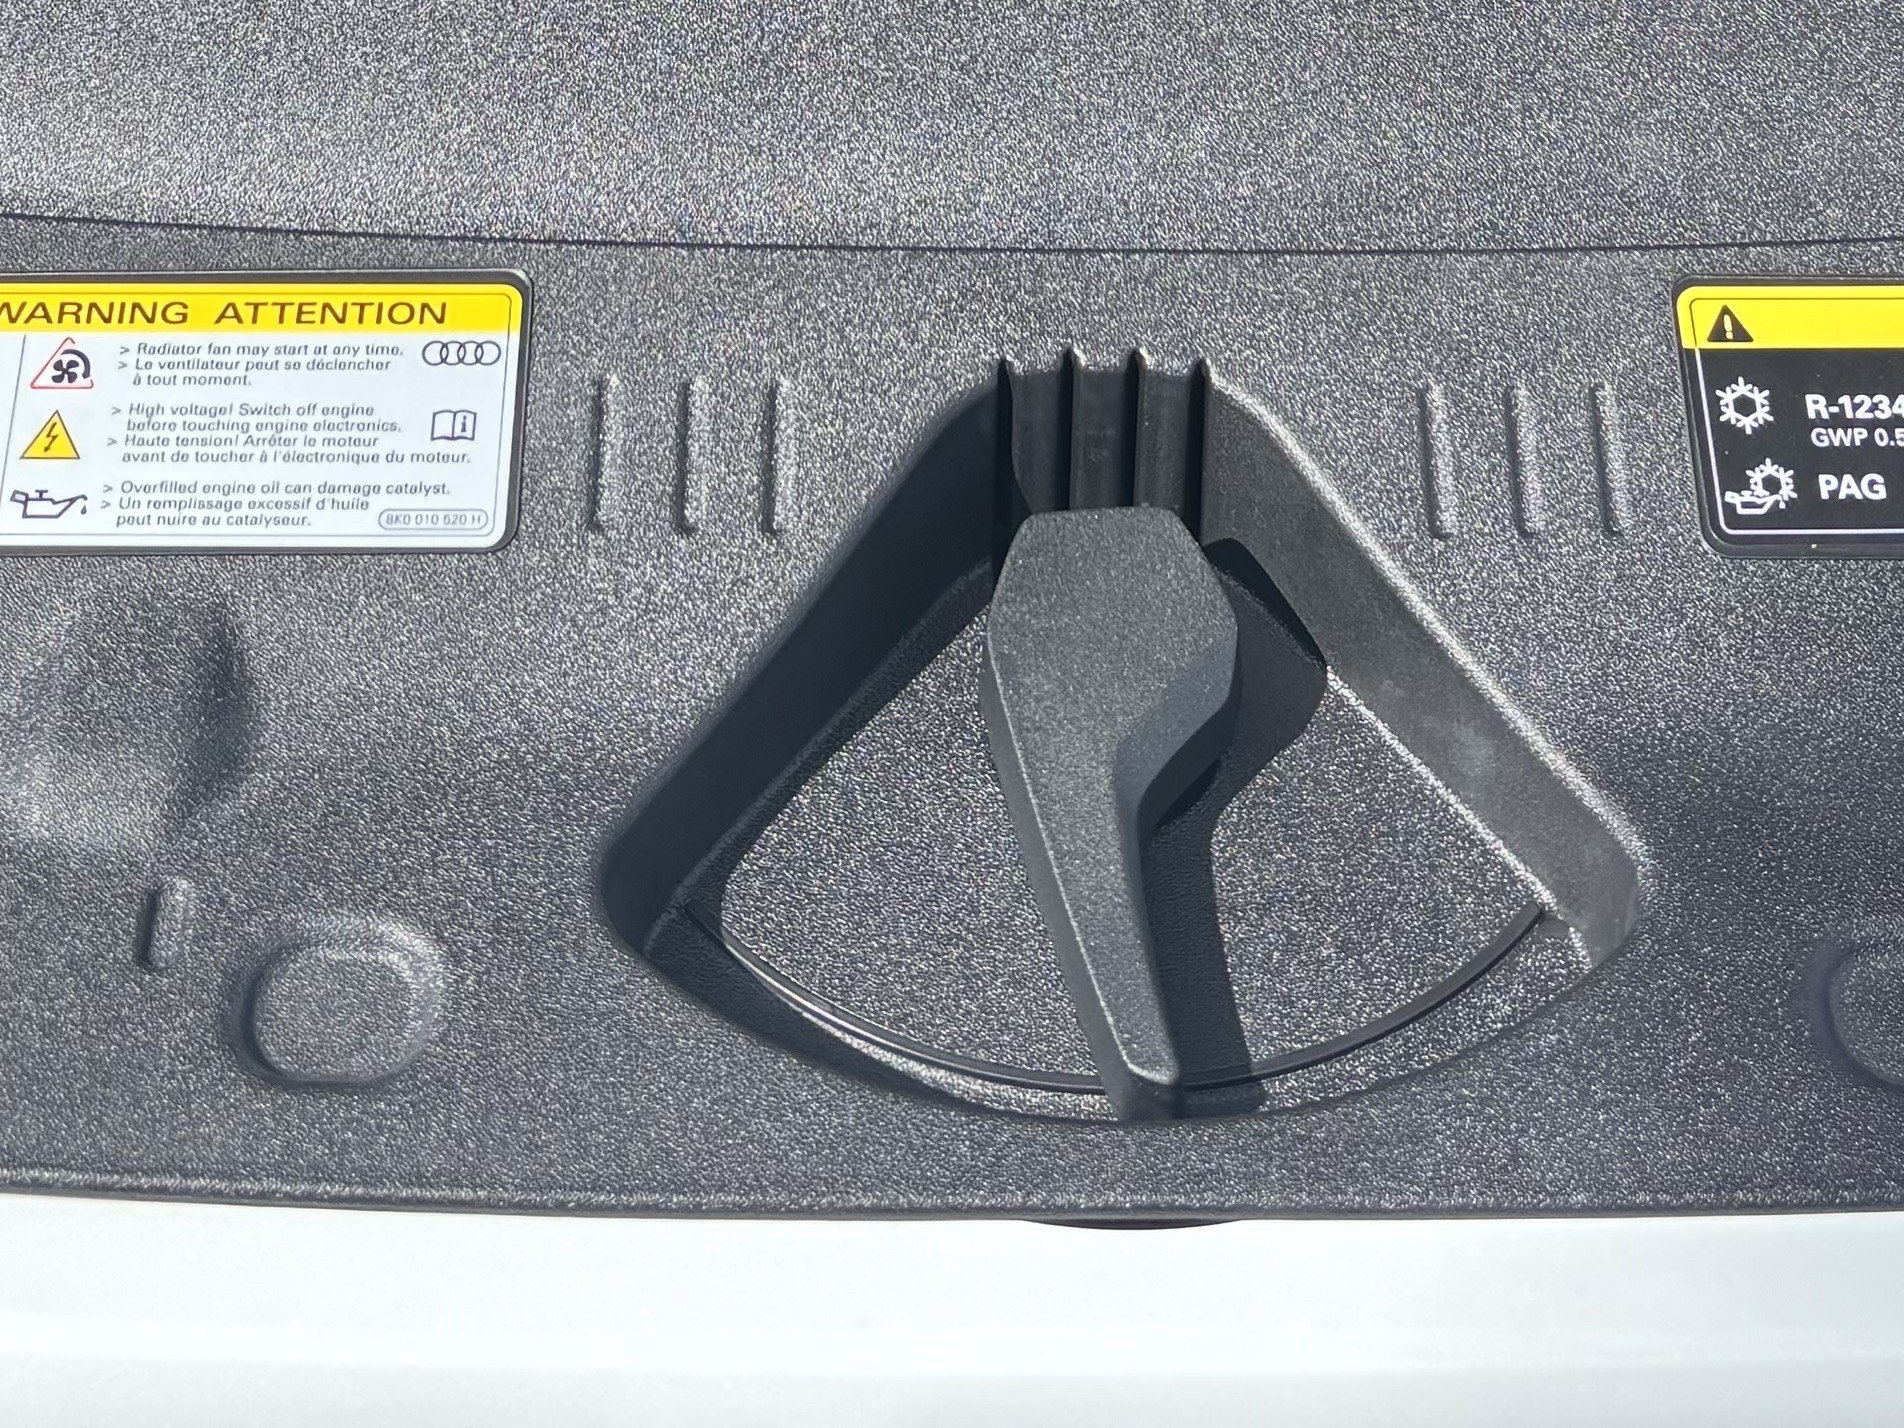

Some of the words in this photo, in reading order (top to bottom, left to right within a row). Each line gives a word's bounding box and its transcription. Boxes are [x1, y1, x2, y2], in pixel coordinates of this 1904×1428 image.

[214, 302, 446, 324] ATTENTION
[138, 343, 202, 355] Radiator
[208, 343, 231, 355] fan
[237, 346, 269, 357] may
[275, 345, 308, 355] start
[314, 345, 327, 355] at
[333, 346, 360, 357] any
[366, 345, 403, 355] time.
[135, 358, 153, 370] Le
[159, 358, 240, 370] ventilateur
[245, 360, 279, 372] peut
[285, 361, 301, 370] se
[147, 375, 177, 385] tout
[183, 375, 251, 385] moment.
[129, 403, 164, 419] High
[171, 403, 233, 418] voltage!
[239, 403, 290, 416] Switch
[296, 403, 317, 416] off
[322, 404, 374, 419] engine
[127, 419, 177, 431] before
[183, 419, 250, 434] touching
[256, 422, 308, 434] engine
[313, 419, 401, 432] electronics.
[125, 434, 170, 446] Haute
[176, 435, 239, 447] tension!
[304, 435, 316, 447] le
[322, 436, 379, 447] moteur
[1811, 428, 1868, 447] GWP
[122, 451, 165, 462] avant
[171, 450, 189, 462] de
[195, 450, 254, 462] toucher
[386, 450, 404, 463] du
[411, 452, 470, 463] moteur.
[121, 481, 197, 494] Overfilled
[203, 482, 255, 496] engine
[261, 481, 279, 494] oil
[285, 484, 311, 494] can
[318, 481, 381, 497] damage
[386, 481, 449, 496] catalyst.
[1819, 473, 1887, 500] PAG
[119, 497, 141, 509] Un
[147, 498, 242, 512] remplissage
[248, 497, 311, 510] excessif
[116, 515, 151, 528] peut
[157, 516, 196, 525] nuire
[202, 516, 221, 526] au
[227, 514, 311, 528] catalyseur.
[415, 514, 439, 525] 010
